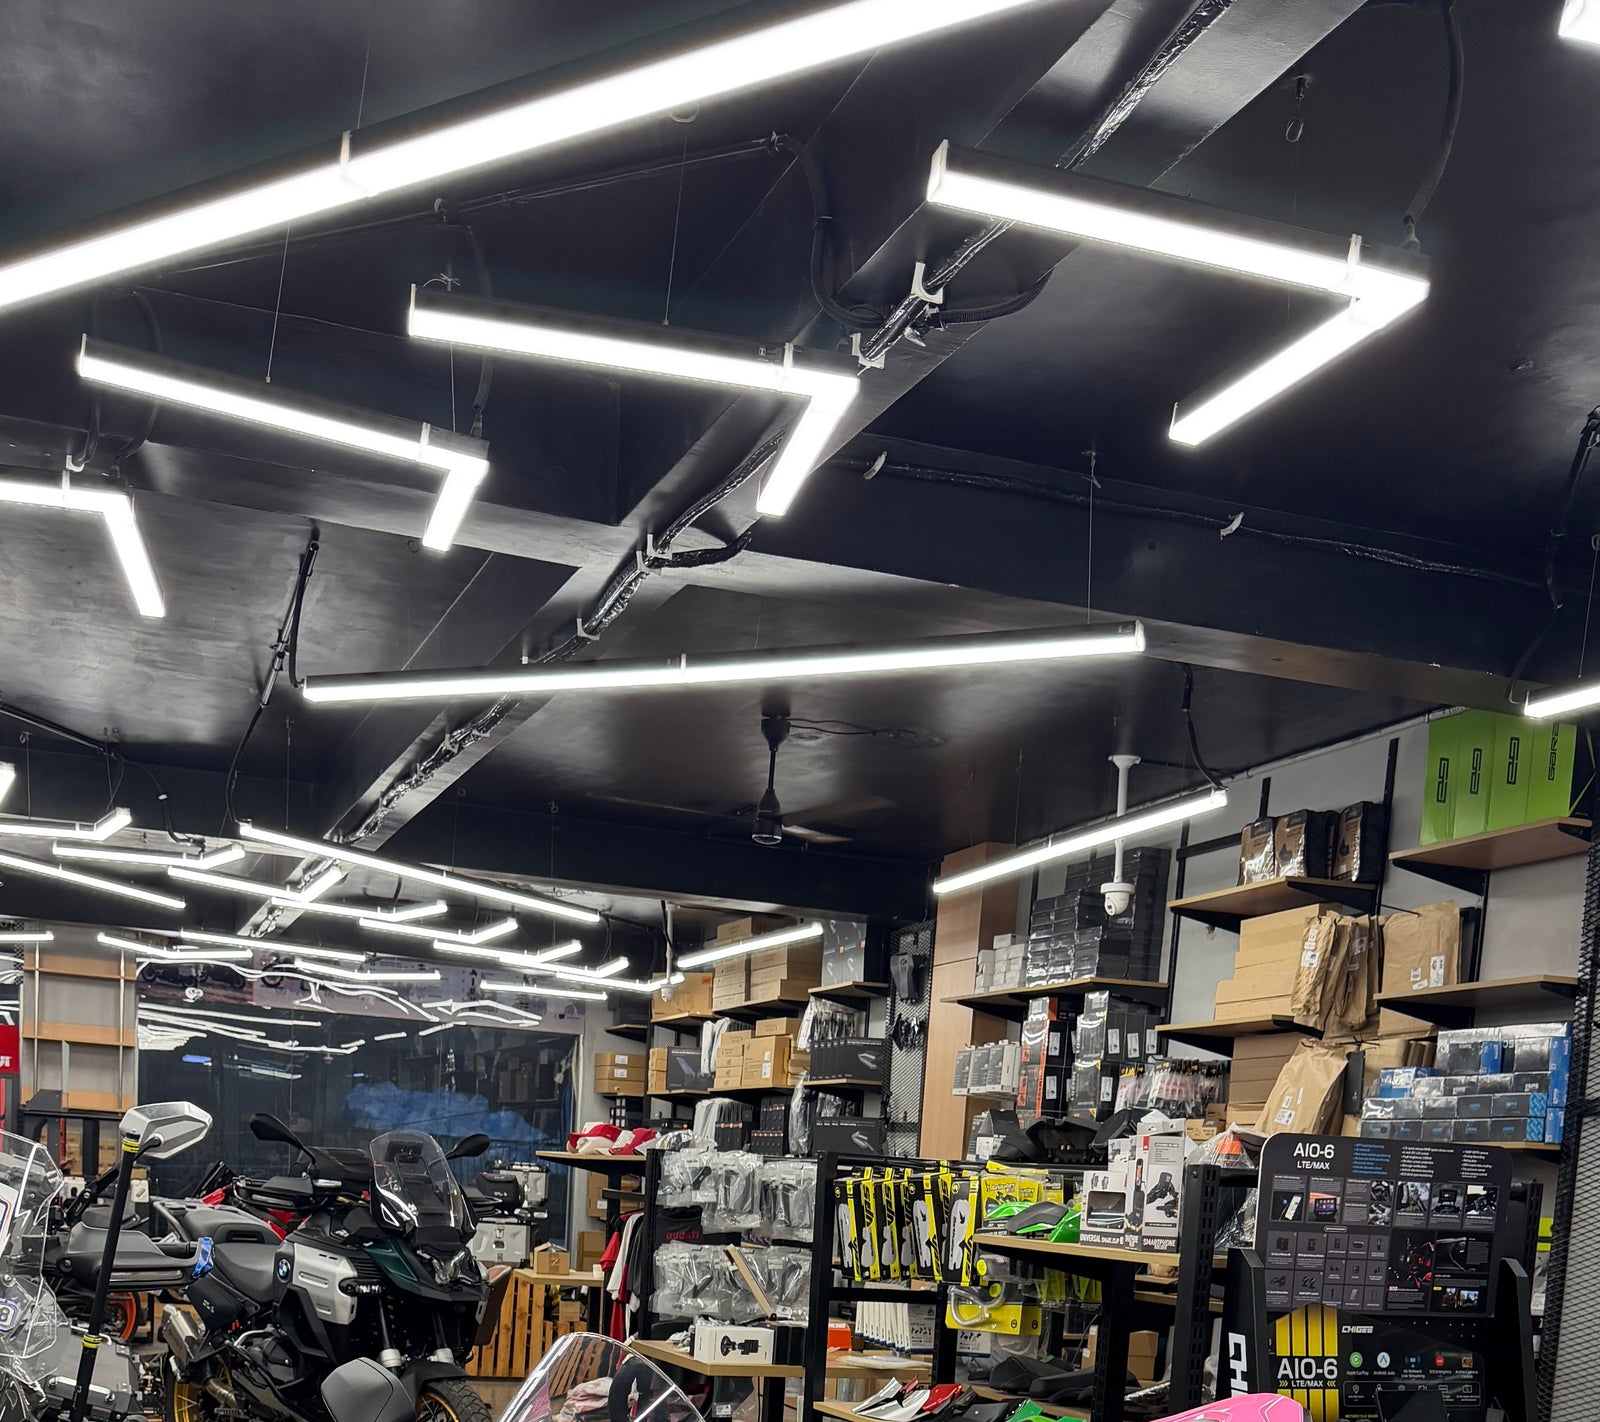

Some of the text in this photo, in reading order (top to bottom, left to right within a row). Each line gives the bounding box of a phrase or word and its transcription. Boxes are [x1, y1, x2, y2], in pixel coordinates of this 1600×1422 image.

[1293, 1142, 1335, 1159] AIO-6
[1297, 1160, 1330, 1170] LTE/MAX
[1341, 1325, 1374, 1334] CHIGEE
[1277, 1358, 1338, 1380] AIO-6
[1291, 1380, 1324, 1388] LTE/MAX
